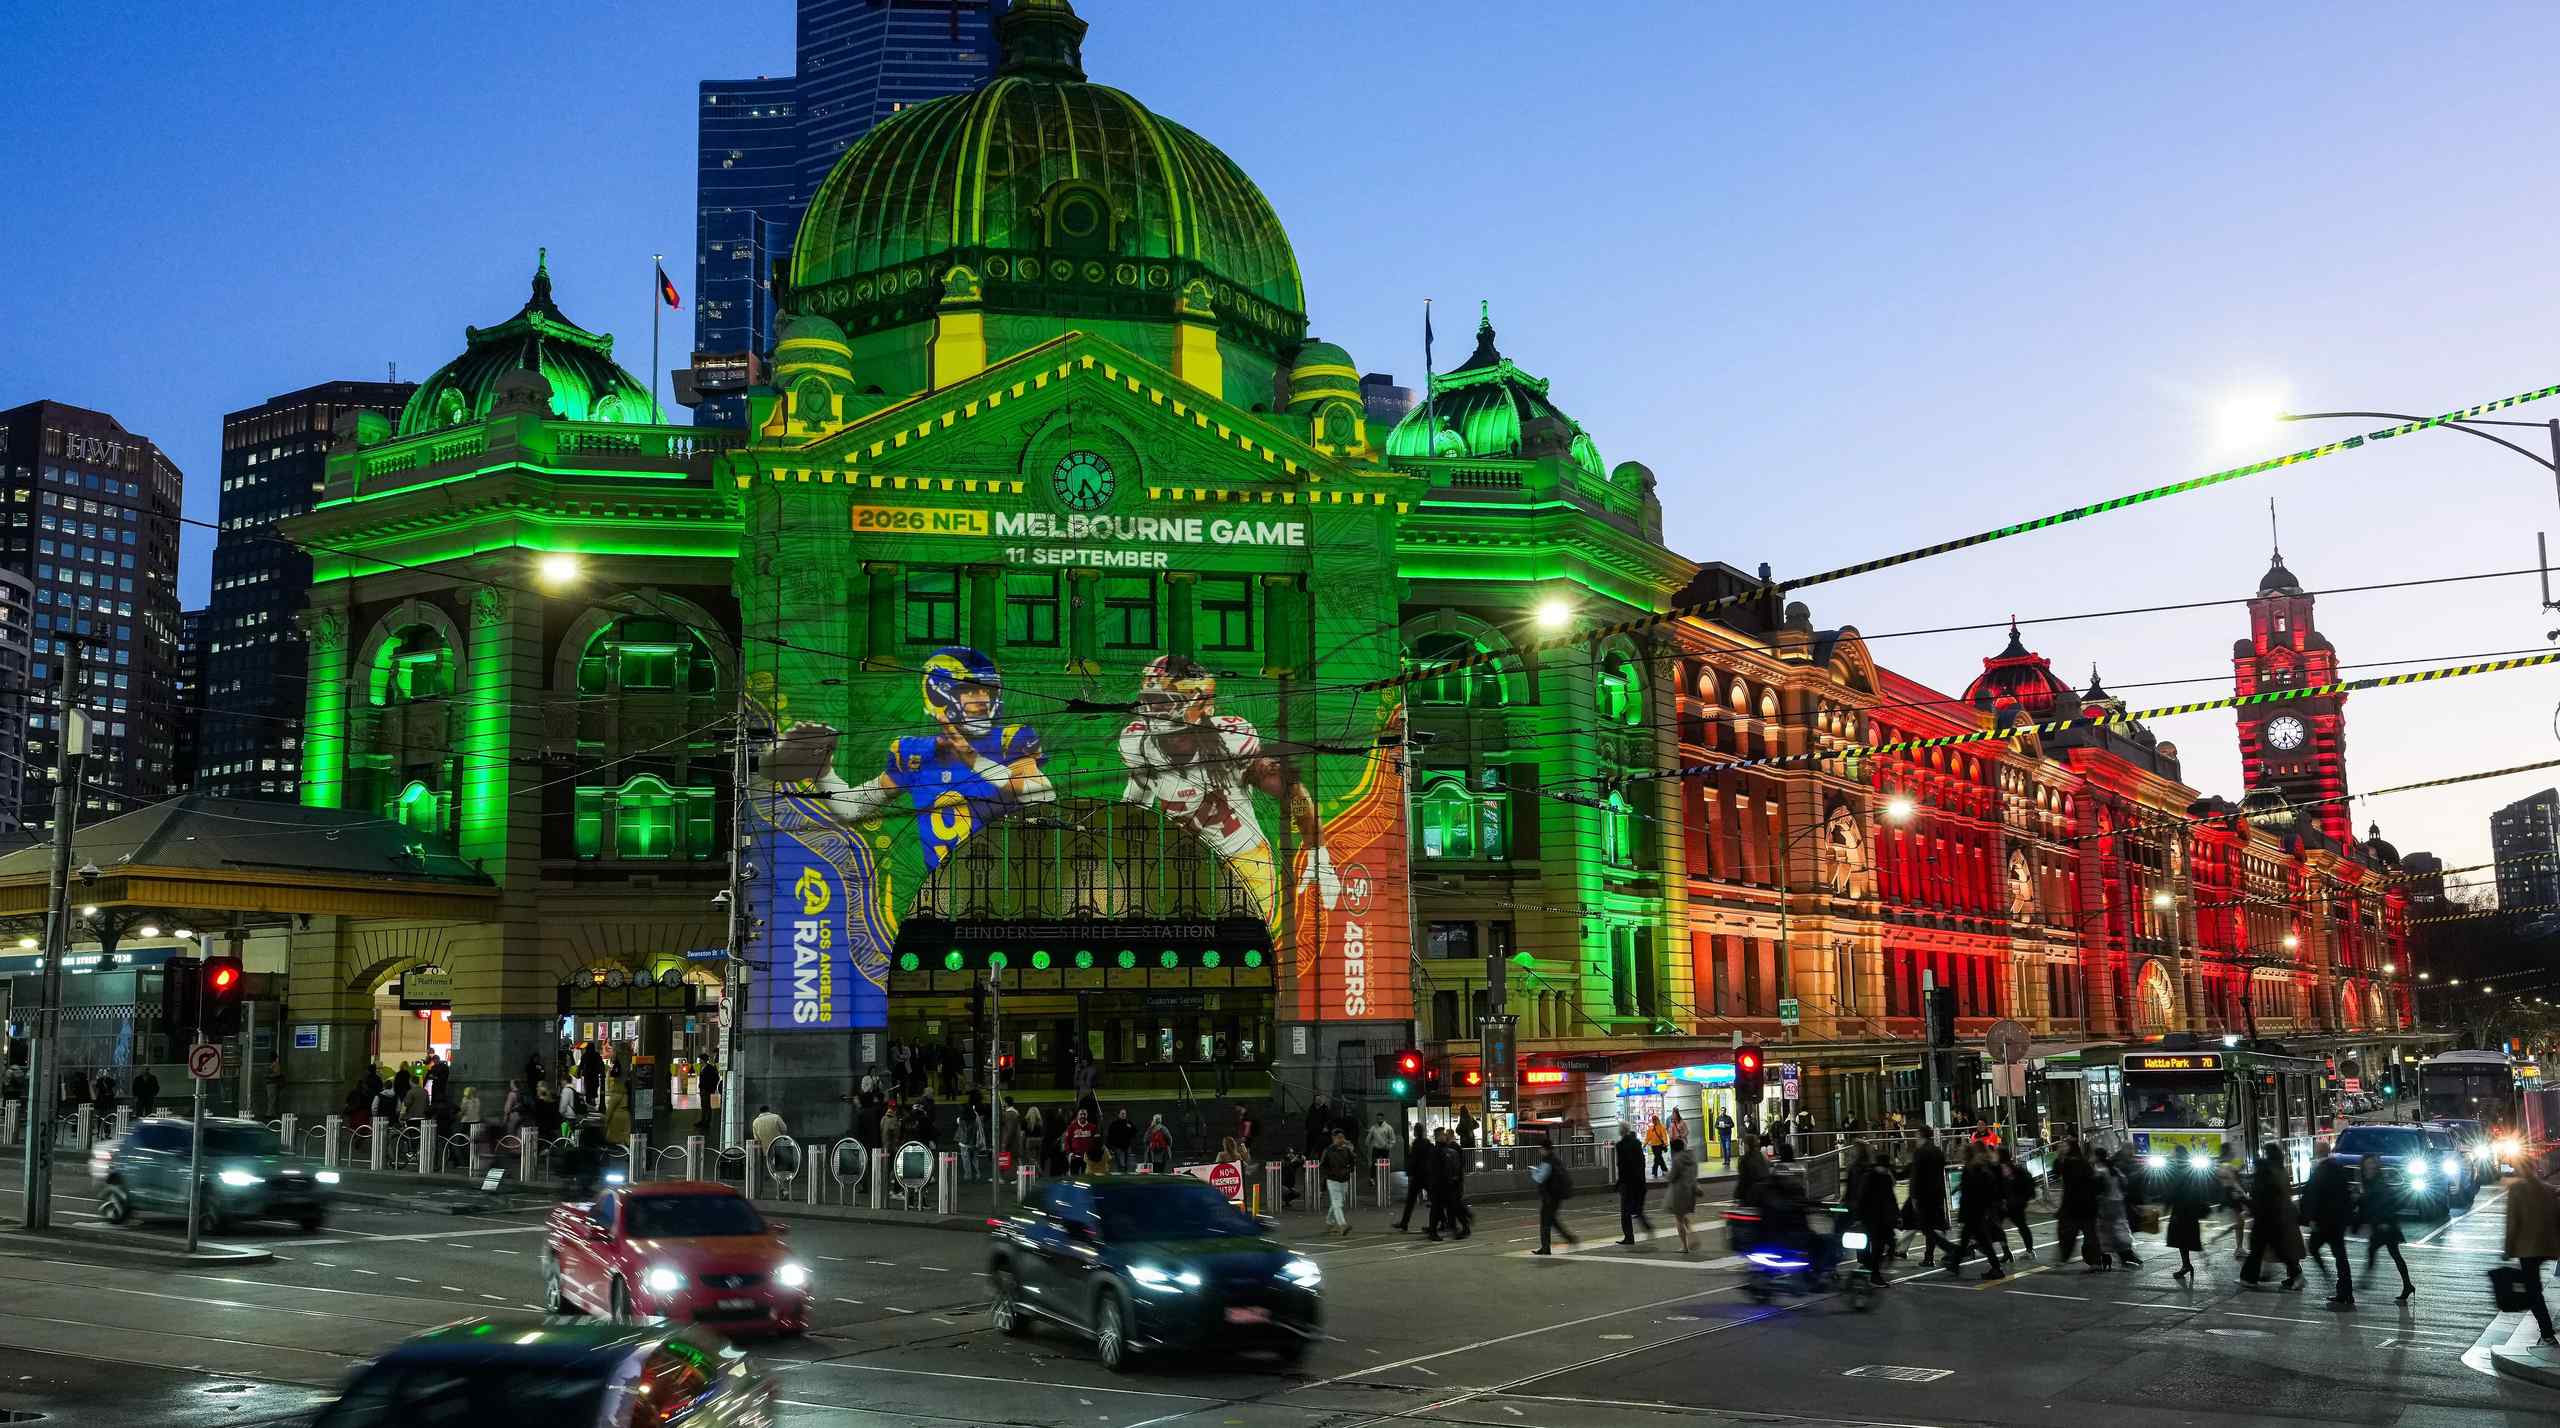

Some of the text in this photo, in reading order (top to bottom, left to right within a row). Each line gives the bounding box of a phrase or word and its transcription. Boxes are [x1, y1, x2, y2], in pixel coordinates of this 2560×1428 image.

[859, 510, 1304, 546] 2026 NFL MELBOURNE GAME
[1006, 548, 1168, 568] 11 SEPTEMBER
[954, 925, 1216, 939] FLINDERS STREET STATION
[793, 921, 818, 1024] RAMS
[820, 919, 832, 1023] LOS ANGELES
[1344, 921, 1365, 1016] 49ERS
[2145, 1057, 2212, 1068] Wattle Park 70
